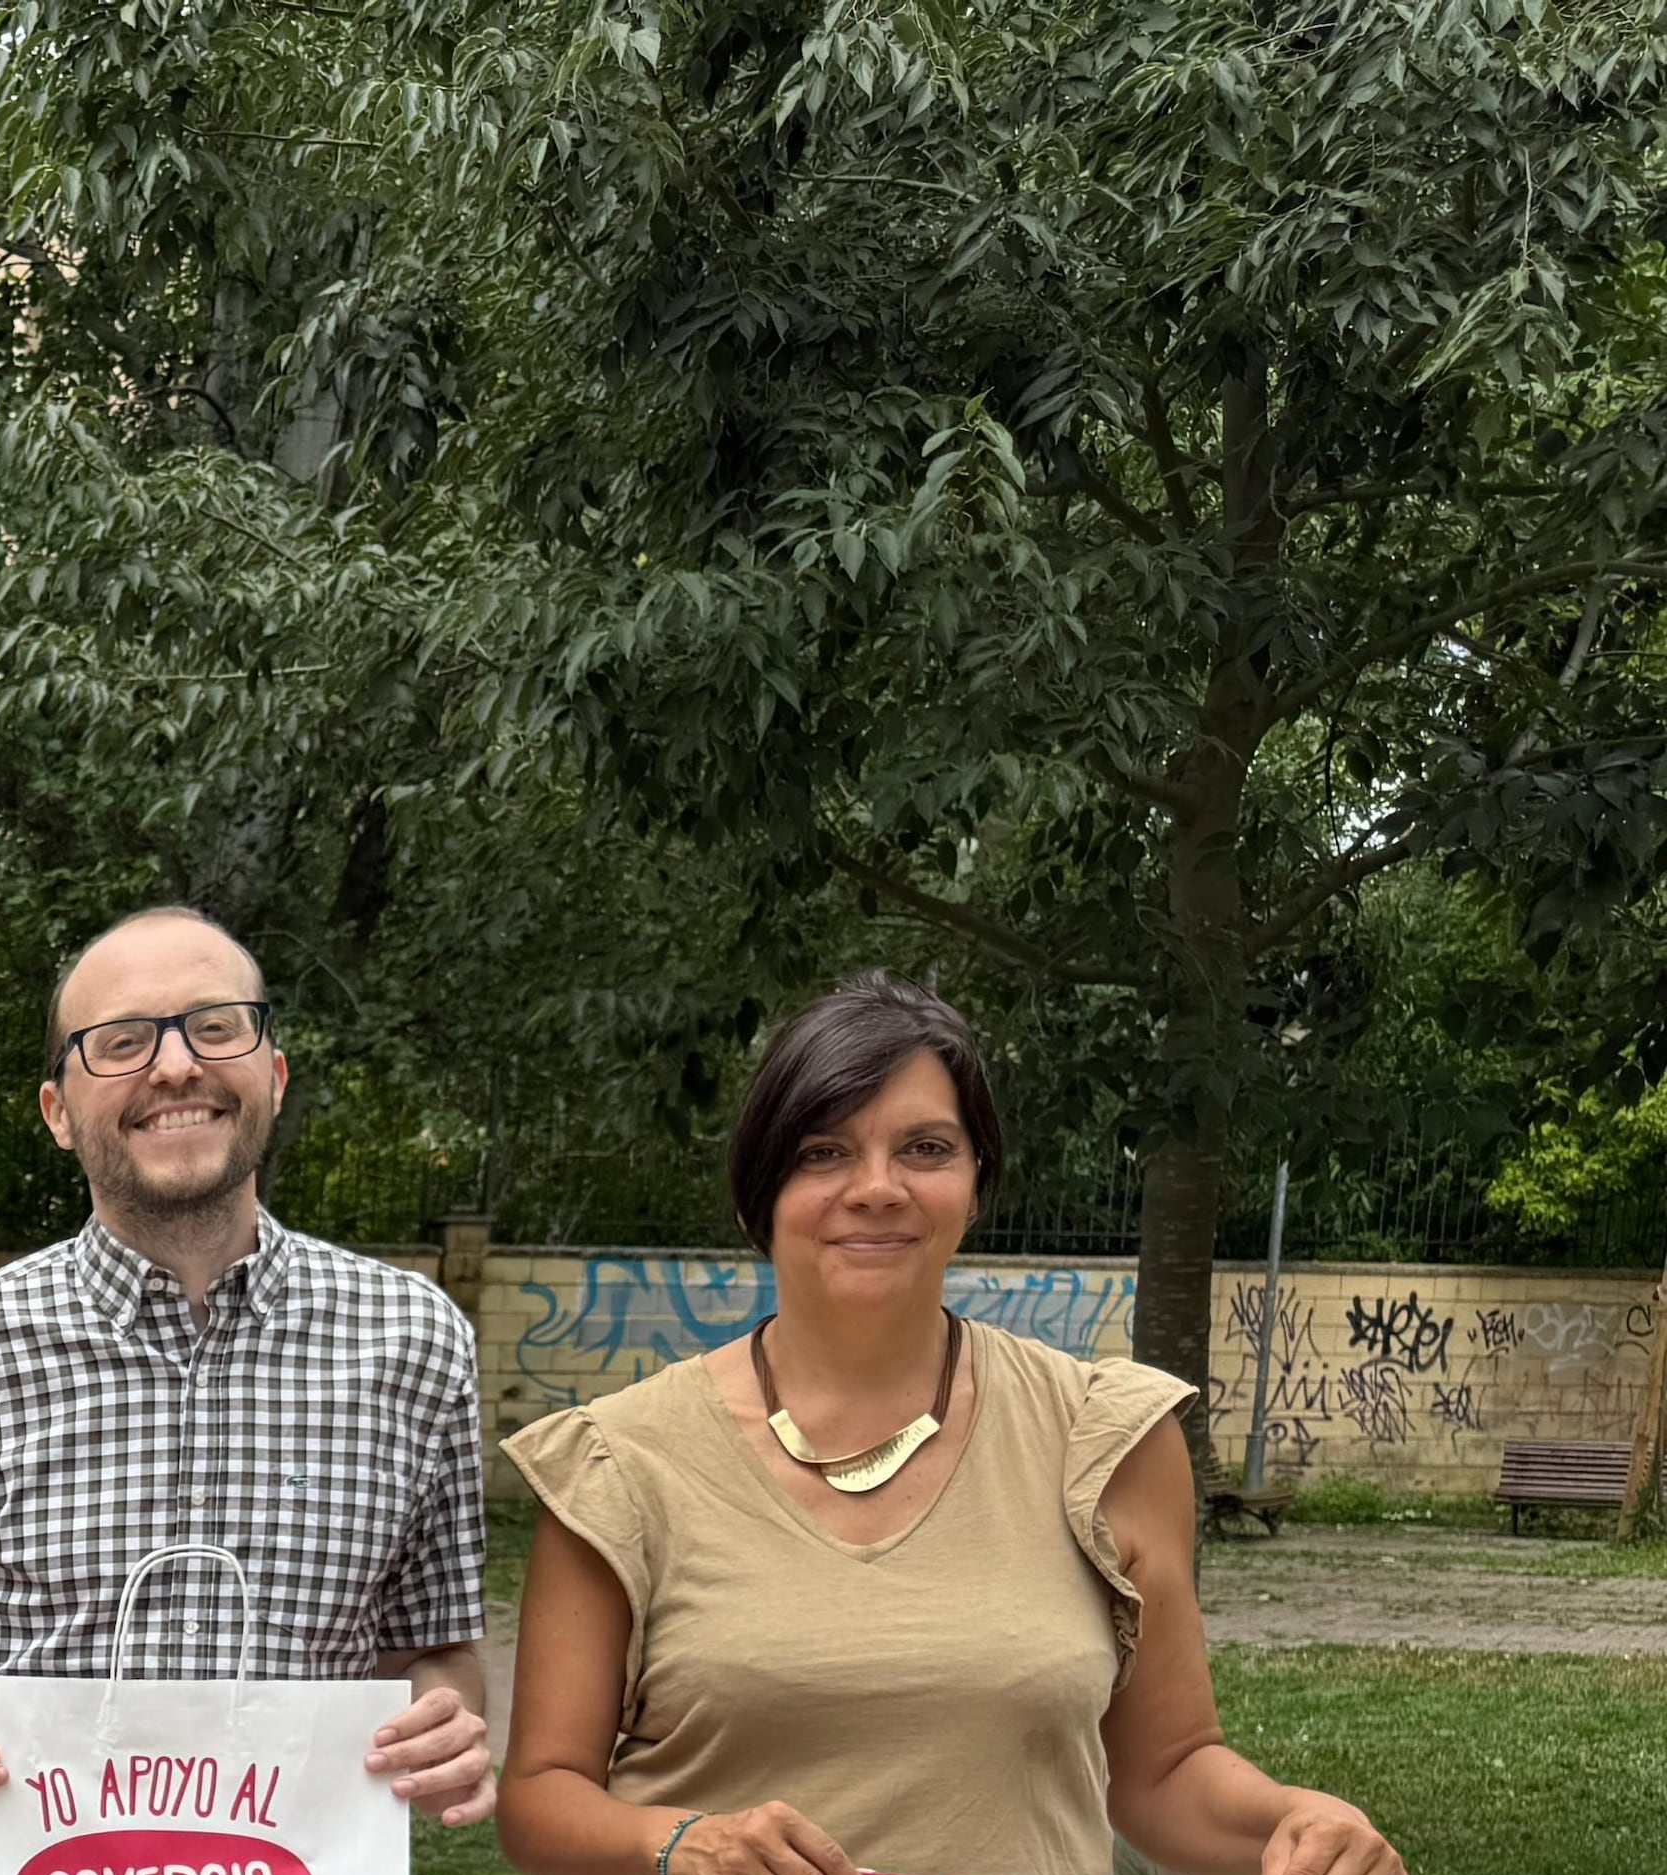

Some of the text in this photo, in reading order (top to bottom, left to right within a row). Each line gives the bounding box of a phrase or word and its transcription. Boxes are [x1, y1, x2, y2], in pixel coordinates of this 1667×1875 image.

[25, 1754, 281, 1833] YO APOYO AL
